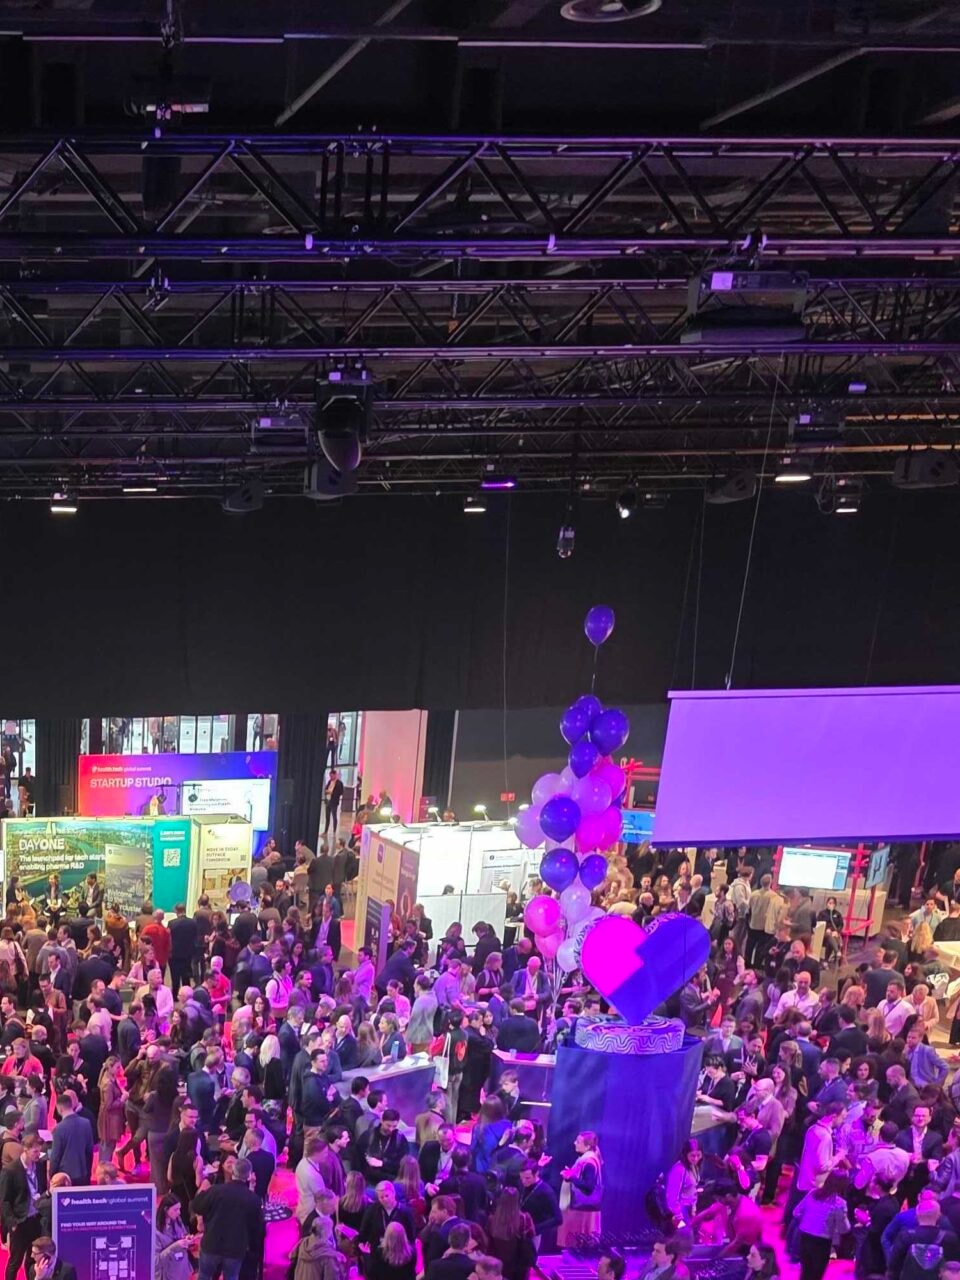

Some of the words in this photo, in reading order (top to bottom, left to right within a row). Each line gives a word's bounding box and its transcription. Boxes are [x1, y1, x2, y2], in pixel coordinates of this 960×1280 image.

[90, 777, 134, 789] STARTUP
[135, 776, 172, 788] STUDIO
[19, 838, 65, 851] DAYONE
[32, 854, 64, 863] launchpad
[65, 854, 73, 862] for
[74, 853, 88, 861] tech
[19, 863, 45, 871] enabling
[46, 862, 69, 871] pharma
[108, 1196, 127, 1205] global
